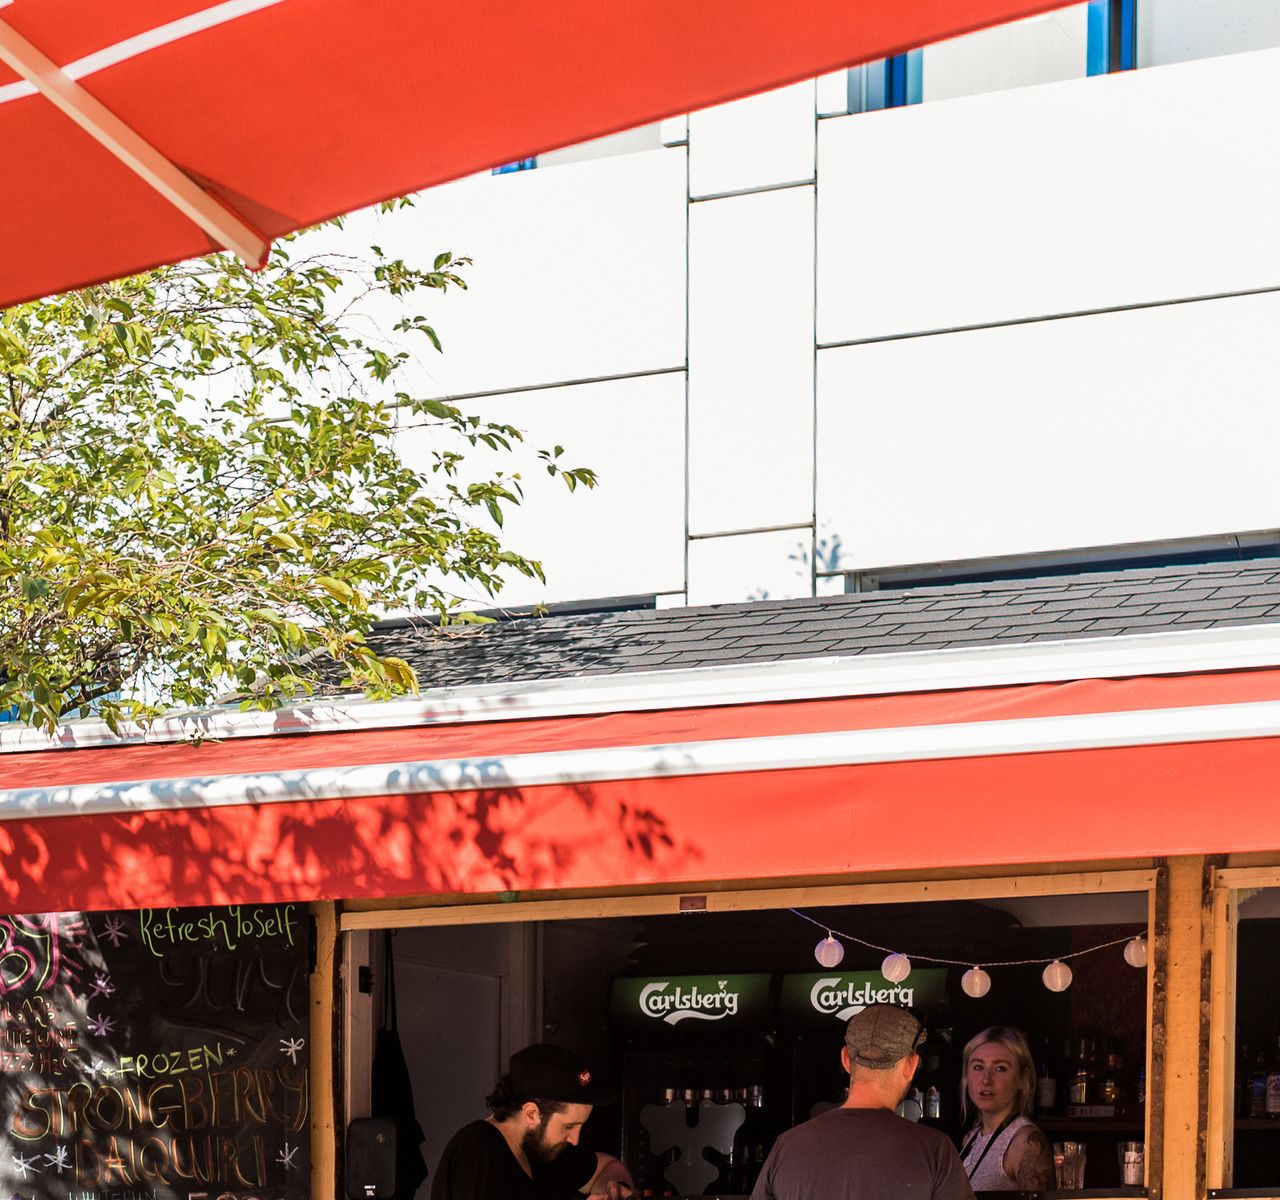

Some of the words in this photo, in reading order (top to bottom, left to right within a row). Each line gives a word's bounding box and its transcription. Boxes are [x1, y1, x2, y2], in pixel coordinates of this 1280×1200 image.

[639, 981, 739, 1026] Carlsberg
[117, 1042, 223, 1079] FROZEN
[74, 1134, 271, 1188] DAIQUIRI
